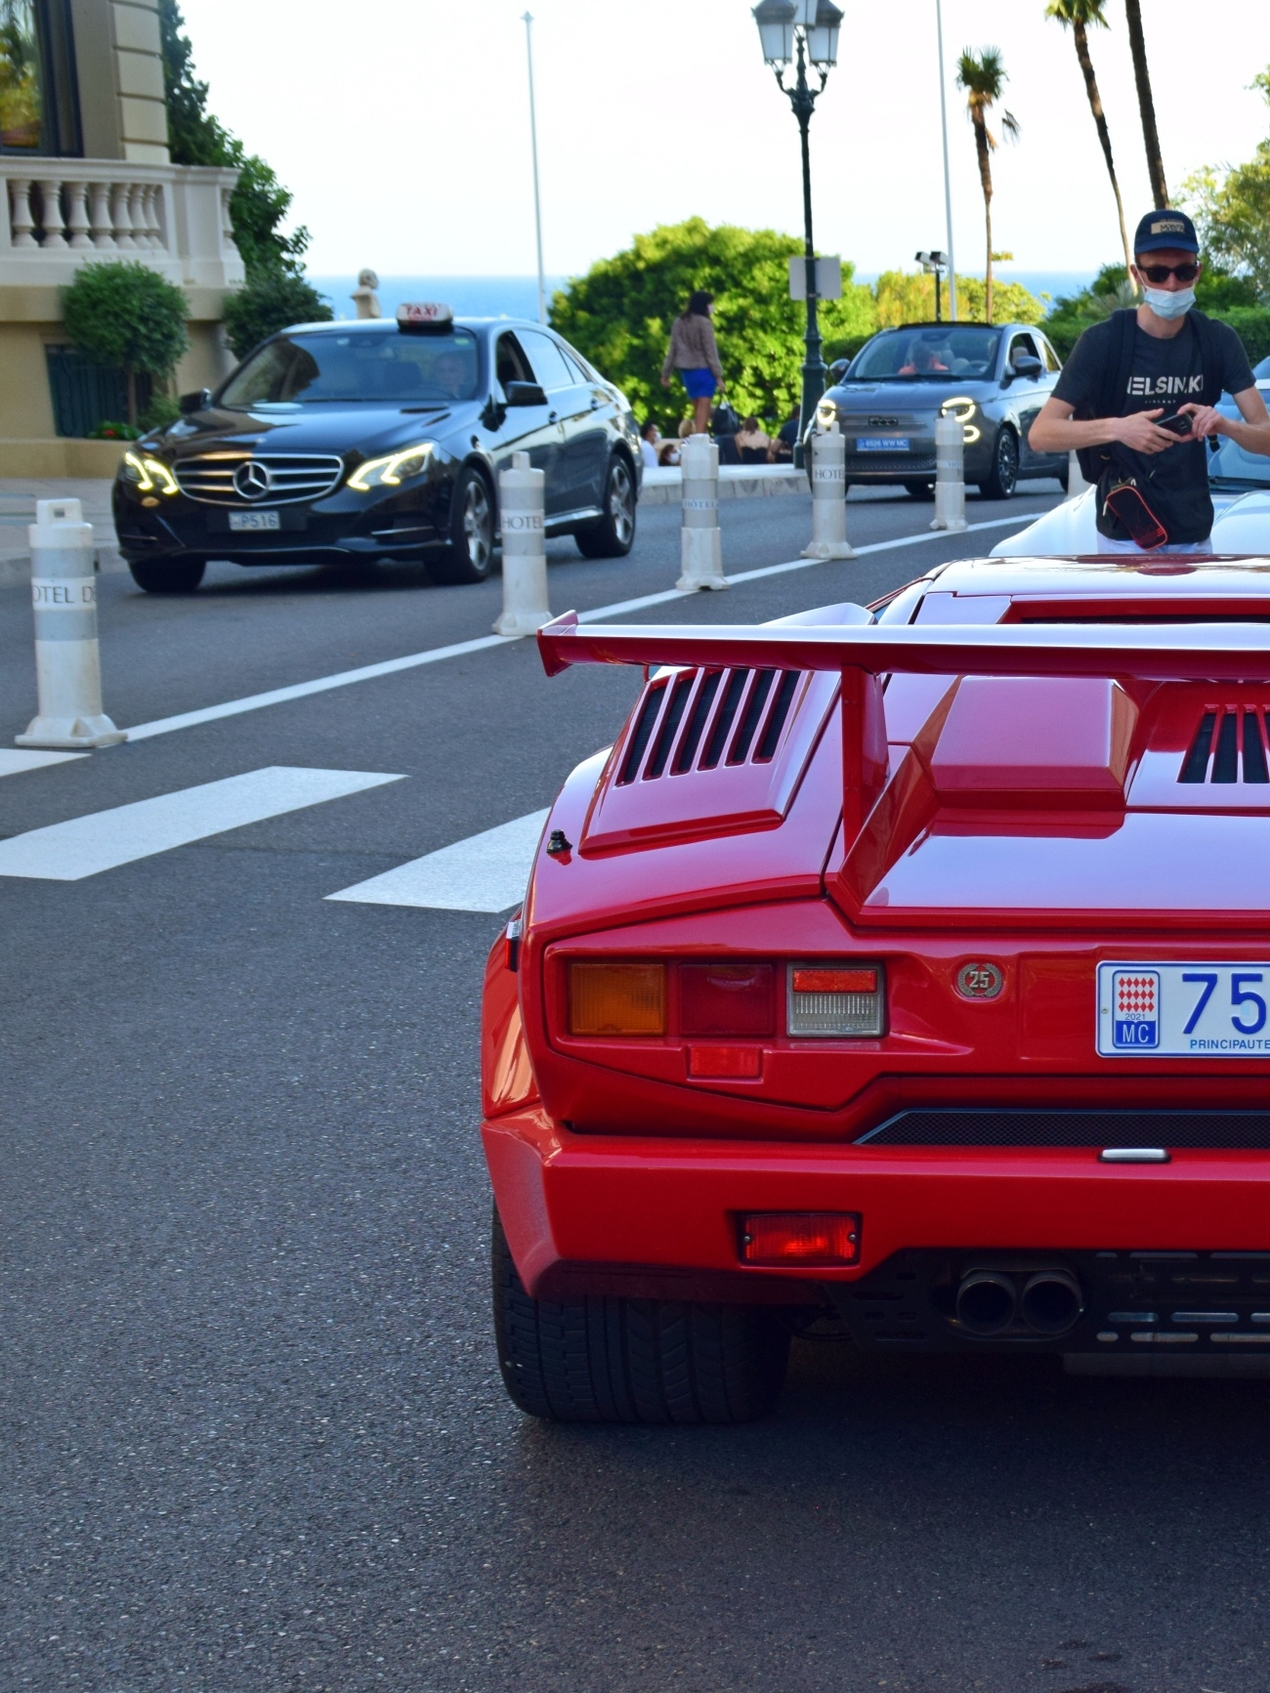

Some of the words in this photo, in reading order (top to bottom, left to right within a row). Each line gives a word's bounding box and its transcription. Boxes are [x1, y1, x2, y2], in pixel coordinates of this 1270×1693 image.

[406, 304, 437, 316] TAXI
[815, 469, 844, 480] HOTE
[32, 585, 75, 604] OTEL
[969, 971, 990, 988] 25
[1124, 1012, 1146, 1021] 2021
[1122, 1024, 1149, 1043] MC
